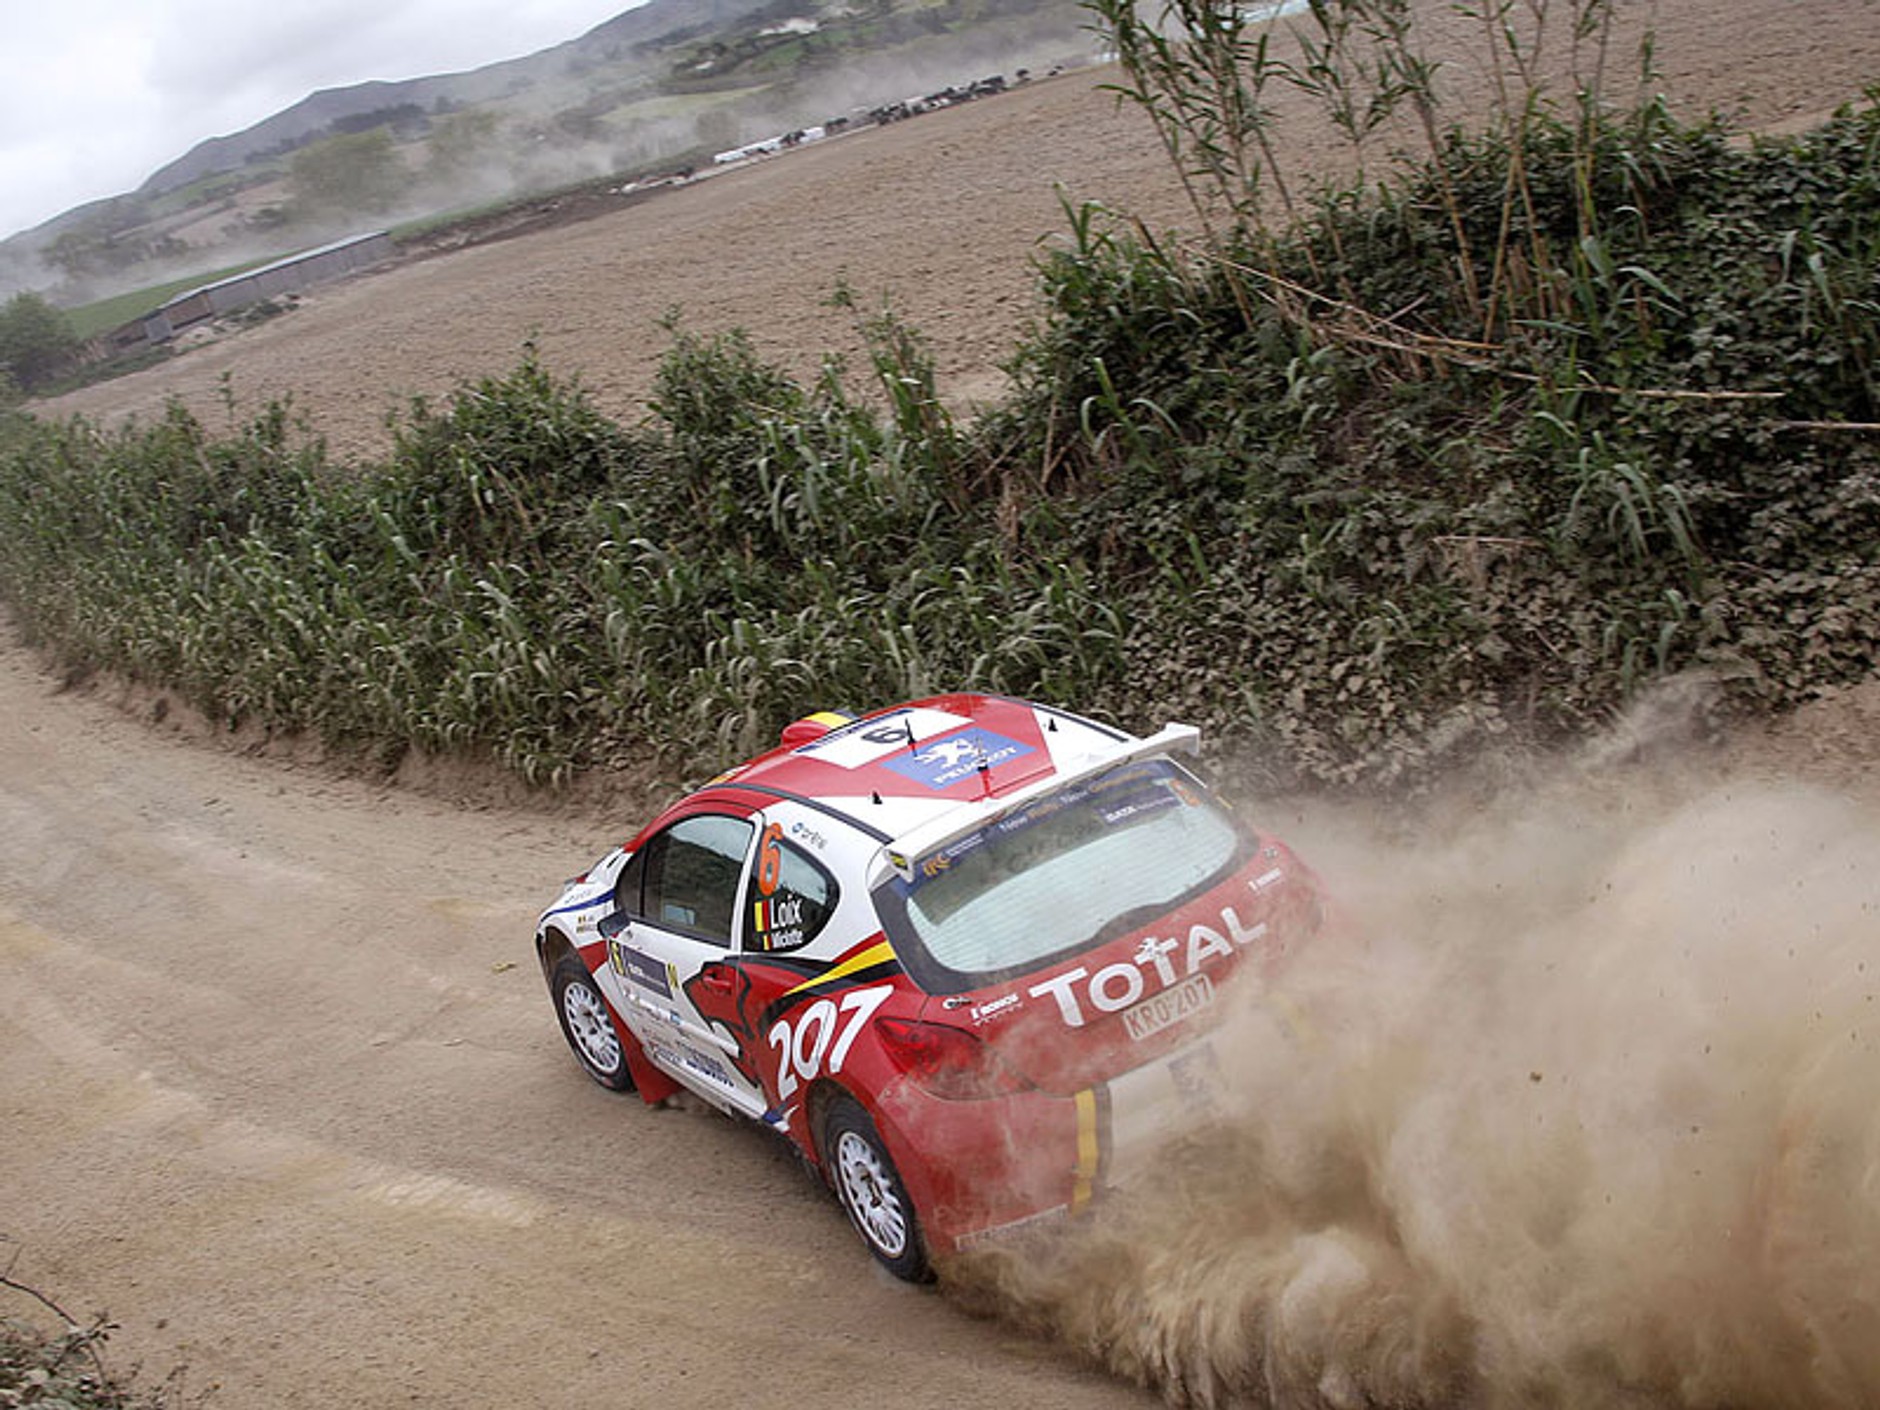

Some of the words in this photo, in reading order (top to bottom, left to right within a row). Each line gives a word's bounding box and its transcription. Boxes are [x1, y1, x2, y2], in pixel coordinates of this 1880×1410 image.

[860, 726, 909, 744] 6
[758, 822, 783, 896] 6
[770, 893, 803, 930] Loix
[1027, 906, 1267, 1027] TOTAL
[768, 974, 895, 1101] 207
